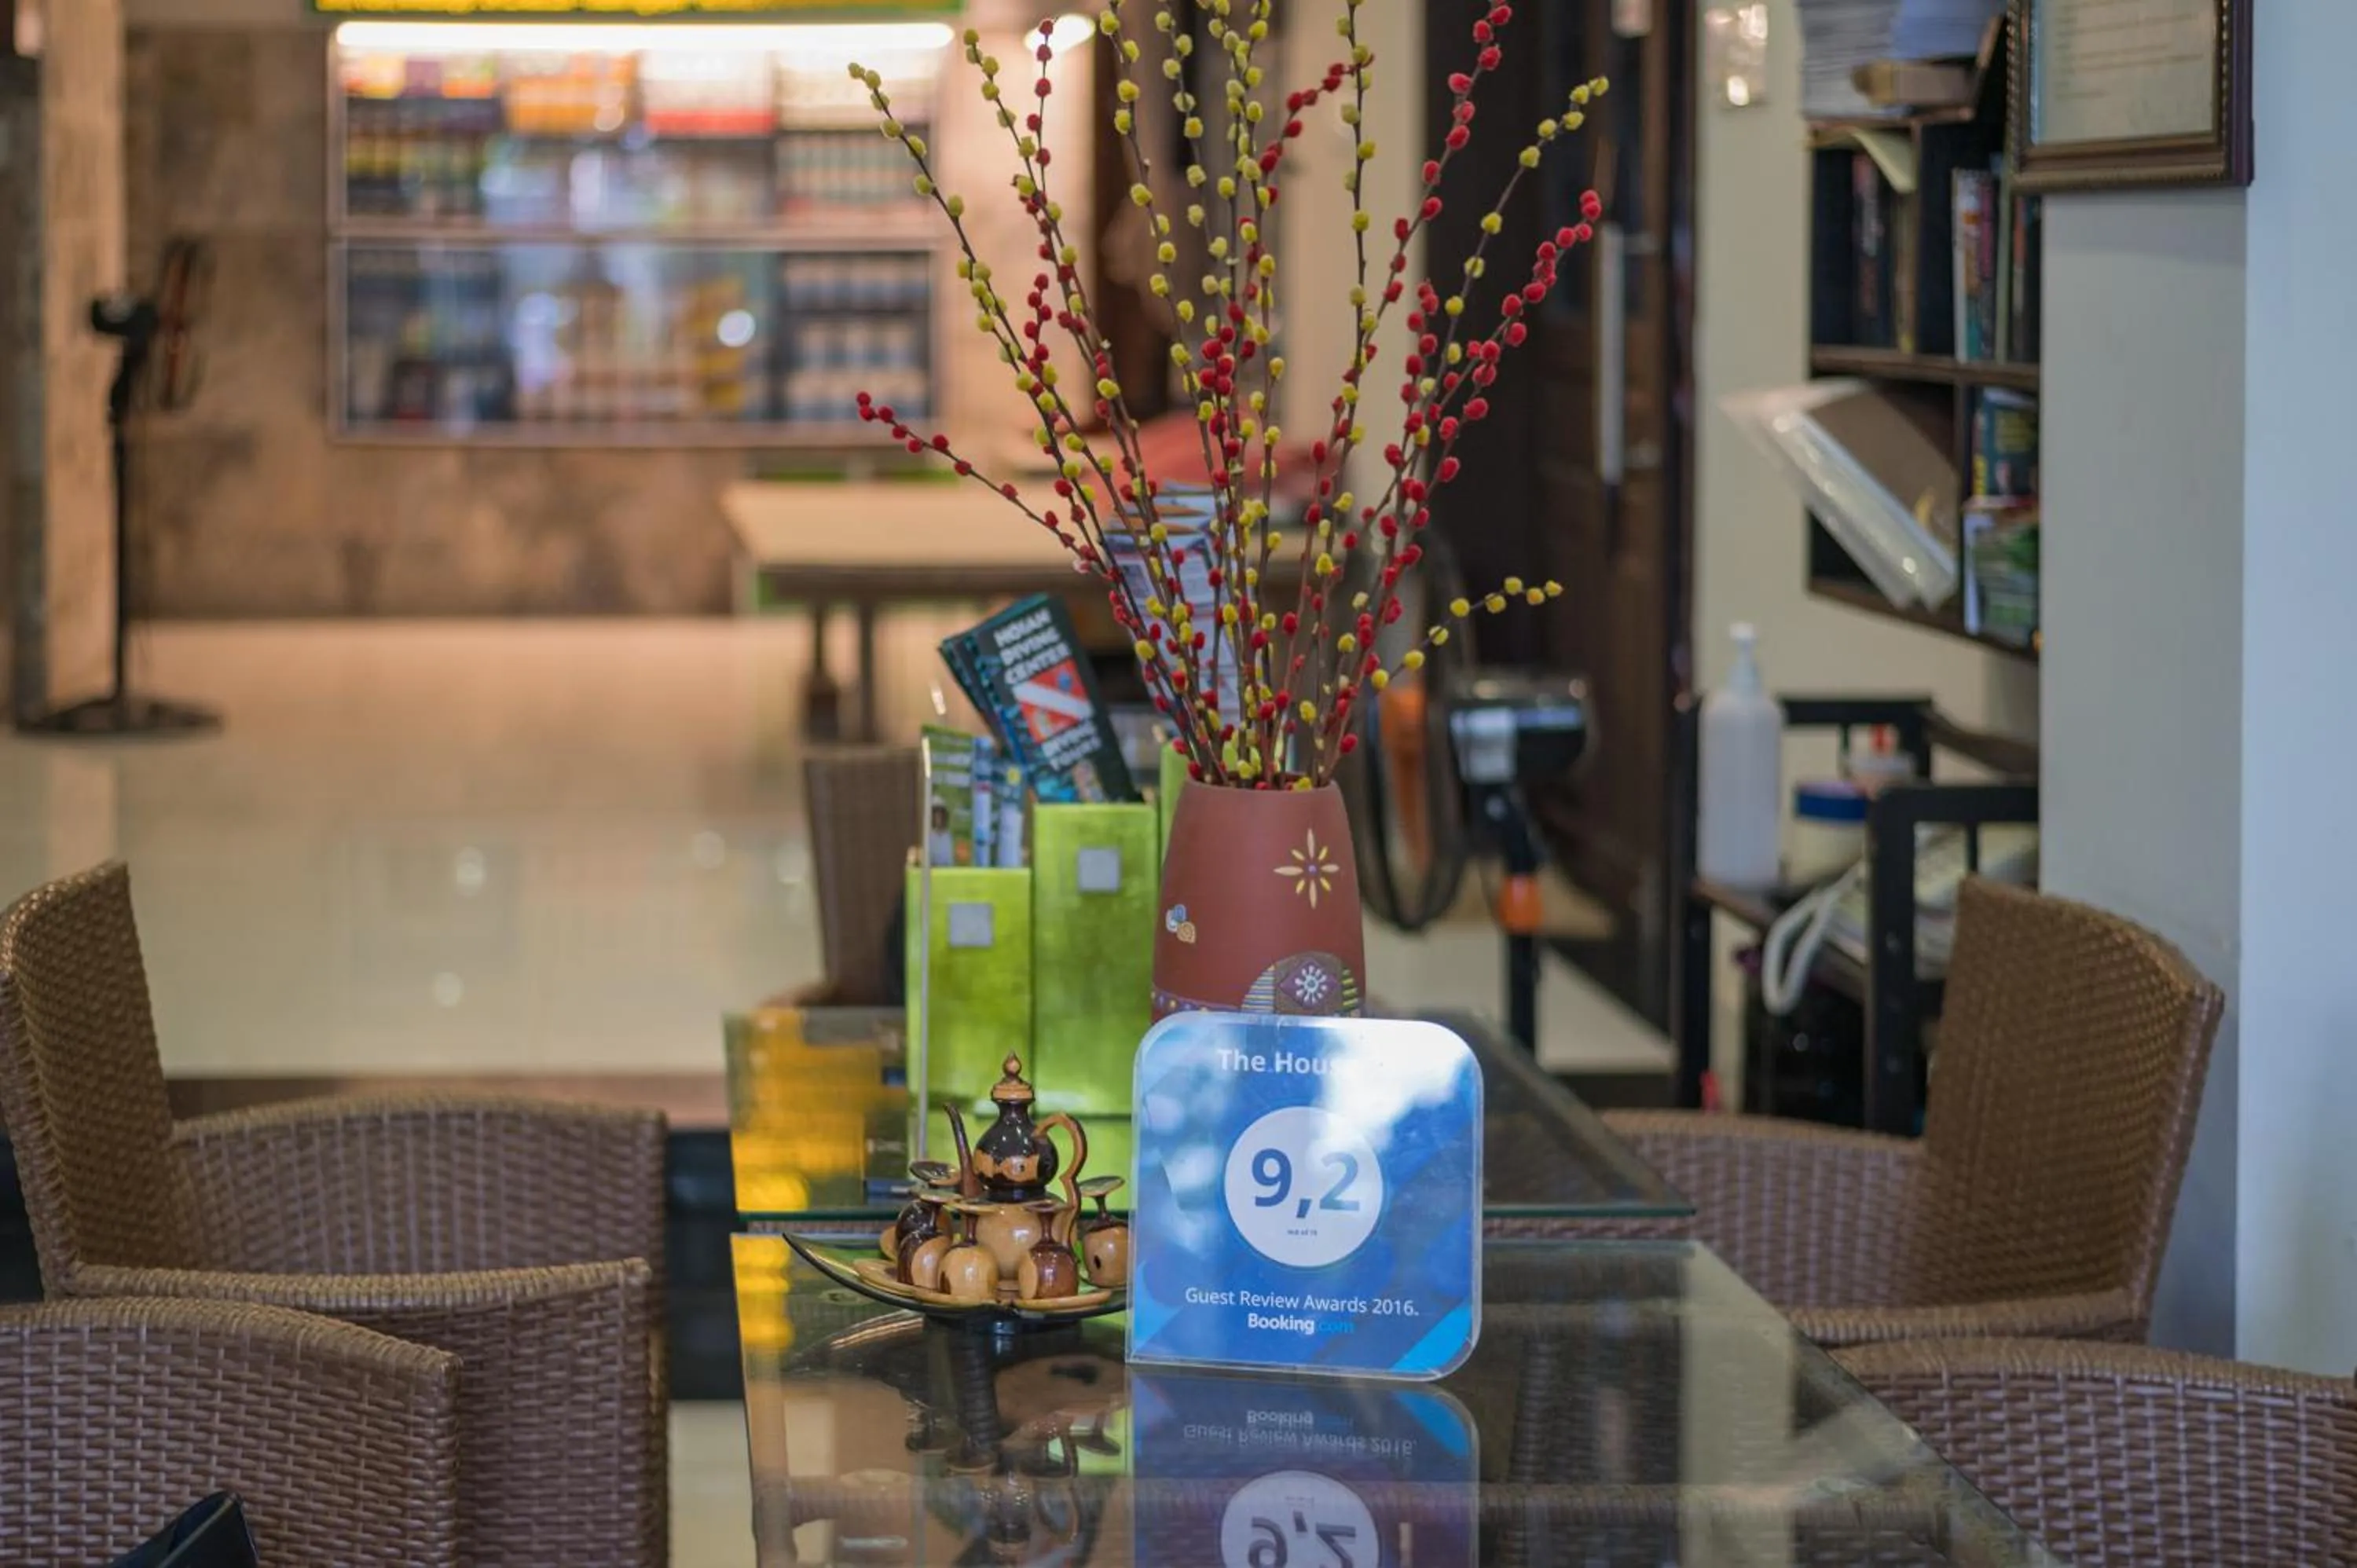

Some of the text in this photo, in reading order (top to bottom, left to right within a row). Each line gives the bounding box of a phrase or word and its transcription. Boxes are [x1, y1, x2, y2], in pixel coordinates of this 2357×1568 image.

[1000, 626, 1061, 666] DIVING
[1005, 641, 1072, 684] CENTER
[1218, 1049, 1332, 1075] The Hou
[1252, 1148, 1360, 1218] 9,2
[1185, 1287, 1419, 1317] Guest Review Awards 2016.
[1248, 1313, 1355, 1335] Bookingcom
